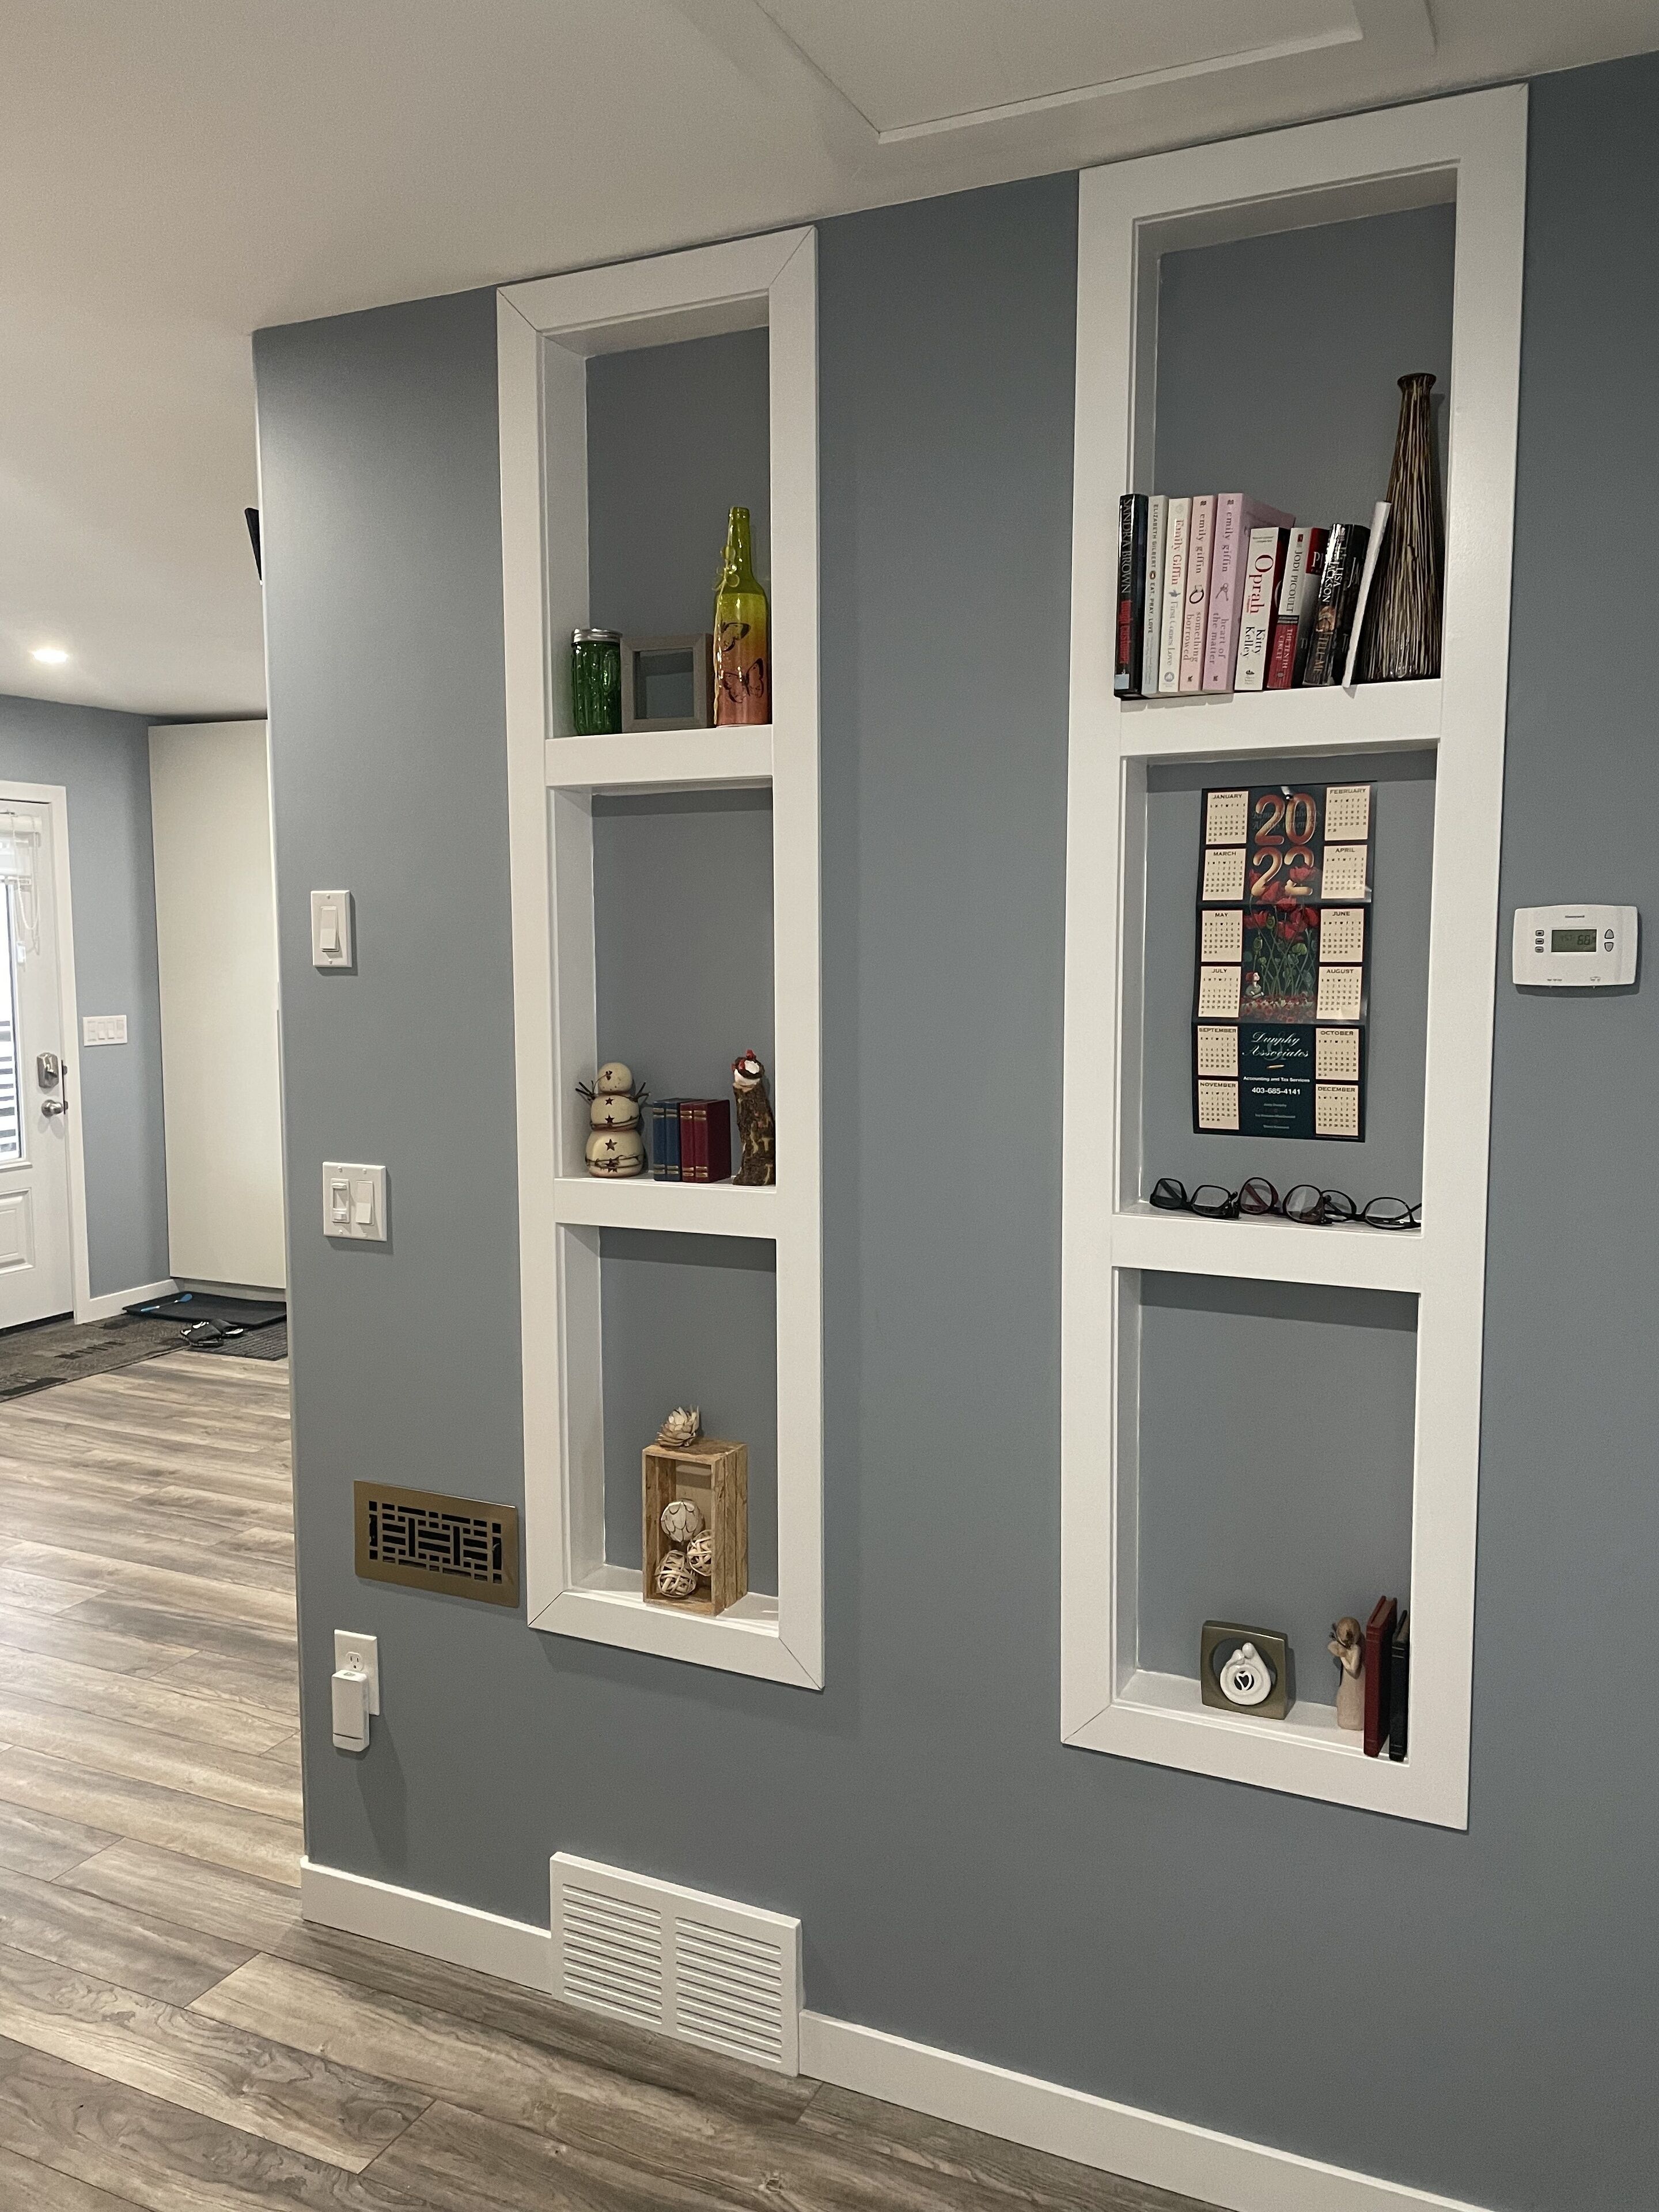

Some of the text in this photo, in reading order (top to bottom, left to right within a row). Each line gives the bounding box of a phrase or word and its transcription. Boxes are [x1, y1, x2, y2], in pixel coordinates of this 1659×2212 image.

[1121, 499, 1132, 593] SANDRA BROWN
[1171, 519, 1184, 585] Emily Giffin
[1195, 514, 1206, 574] emily giffin
[1222, 512, 1233, 572] emily giffin
[1249, 554, 1274, 614] Oprah
[1286, 551, 1302, 613] JODI PICOULT
[1322, 561, 1340, 603] JACKSON
[1333, 567, 1344, 587] LISA
[1183, 614, 1194, 661] borrowed
[1191, 612, 1202, 662] something
[1209, 613, 1221, 664] the matter
[1218, 619, 1229, 659] heart of
[1240, 627, 1255, 660] Kelley
[1252, 629, 1266, 656] Kitty
[1255, 793, 1316, 845] 20
[1251, 846, 1314, 895] 22
[1242, 1046, 1309, 1058] Associates
[1251, 1032, 1301, 1047] Dunphy
